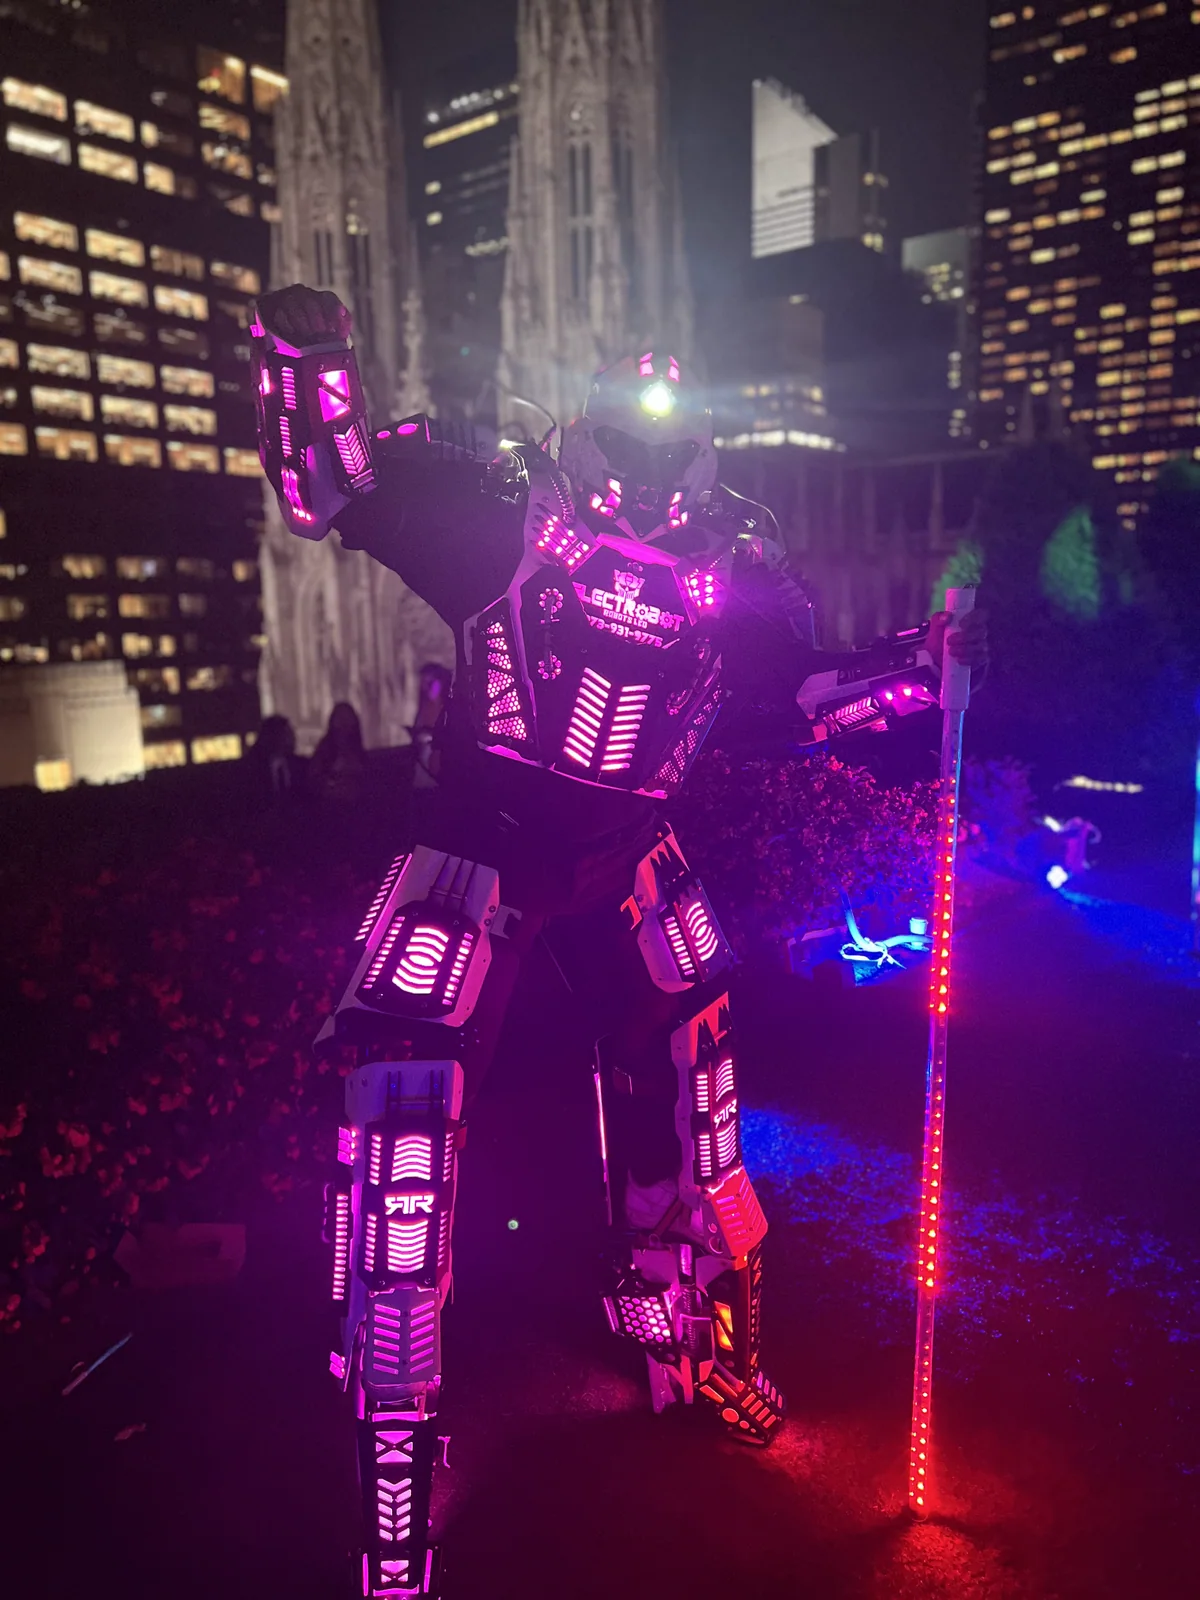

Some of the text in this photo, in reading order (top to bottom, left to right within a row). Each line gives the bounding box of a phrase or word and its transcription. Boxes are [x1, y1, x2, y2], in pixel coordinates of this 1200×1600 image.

[572, 581, 684, 632] LECTROBOT
[603, 608, 648, 629] ROBOTS LED
